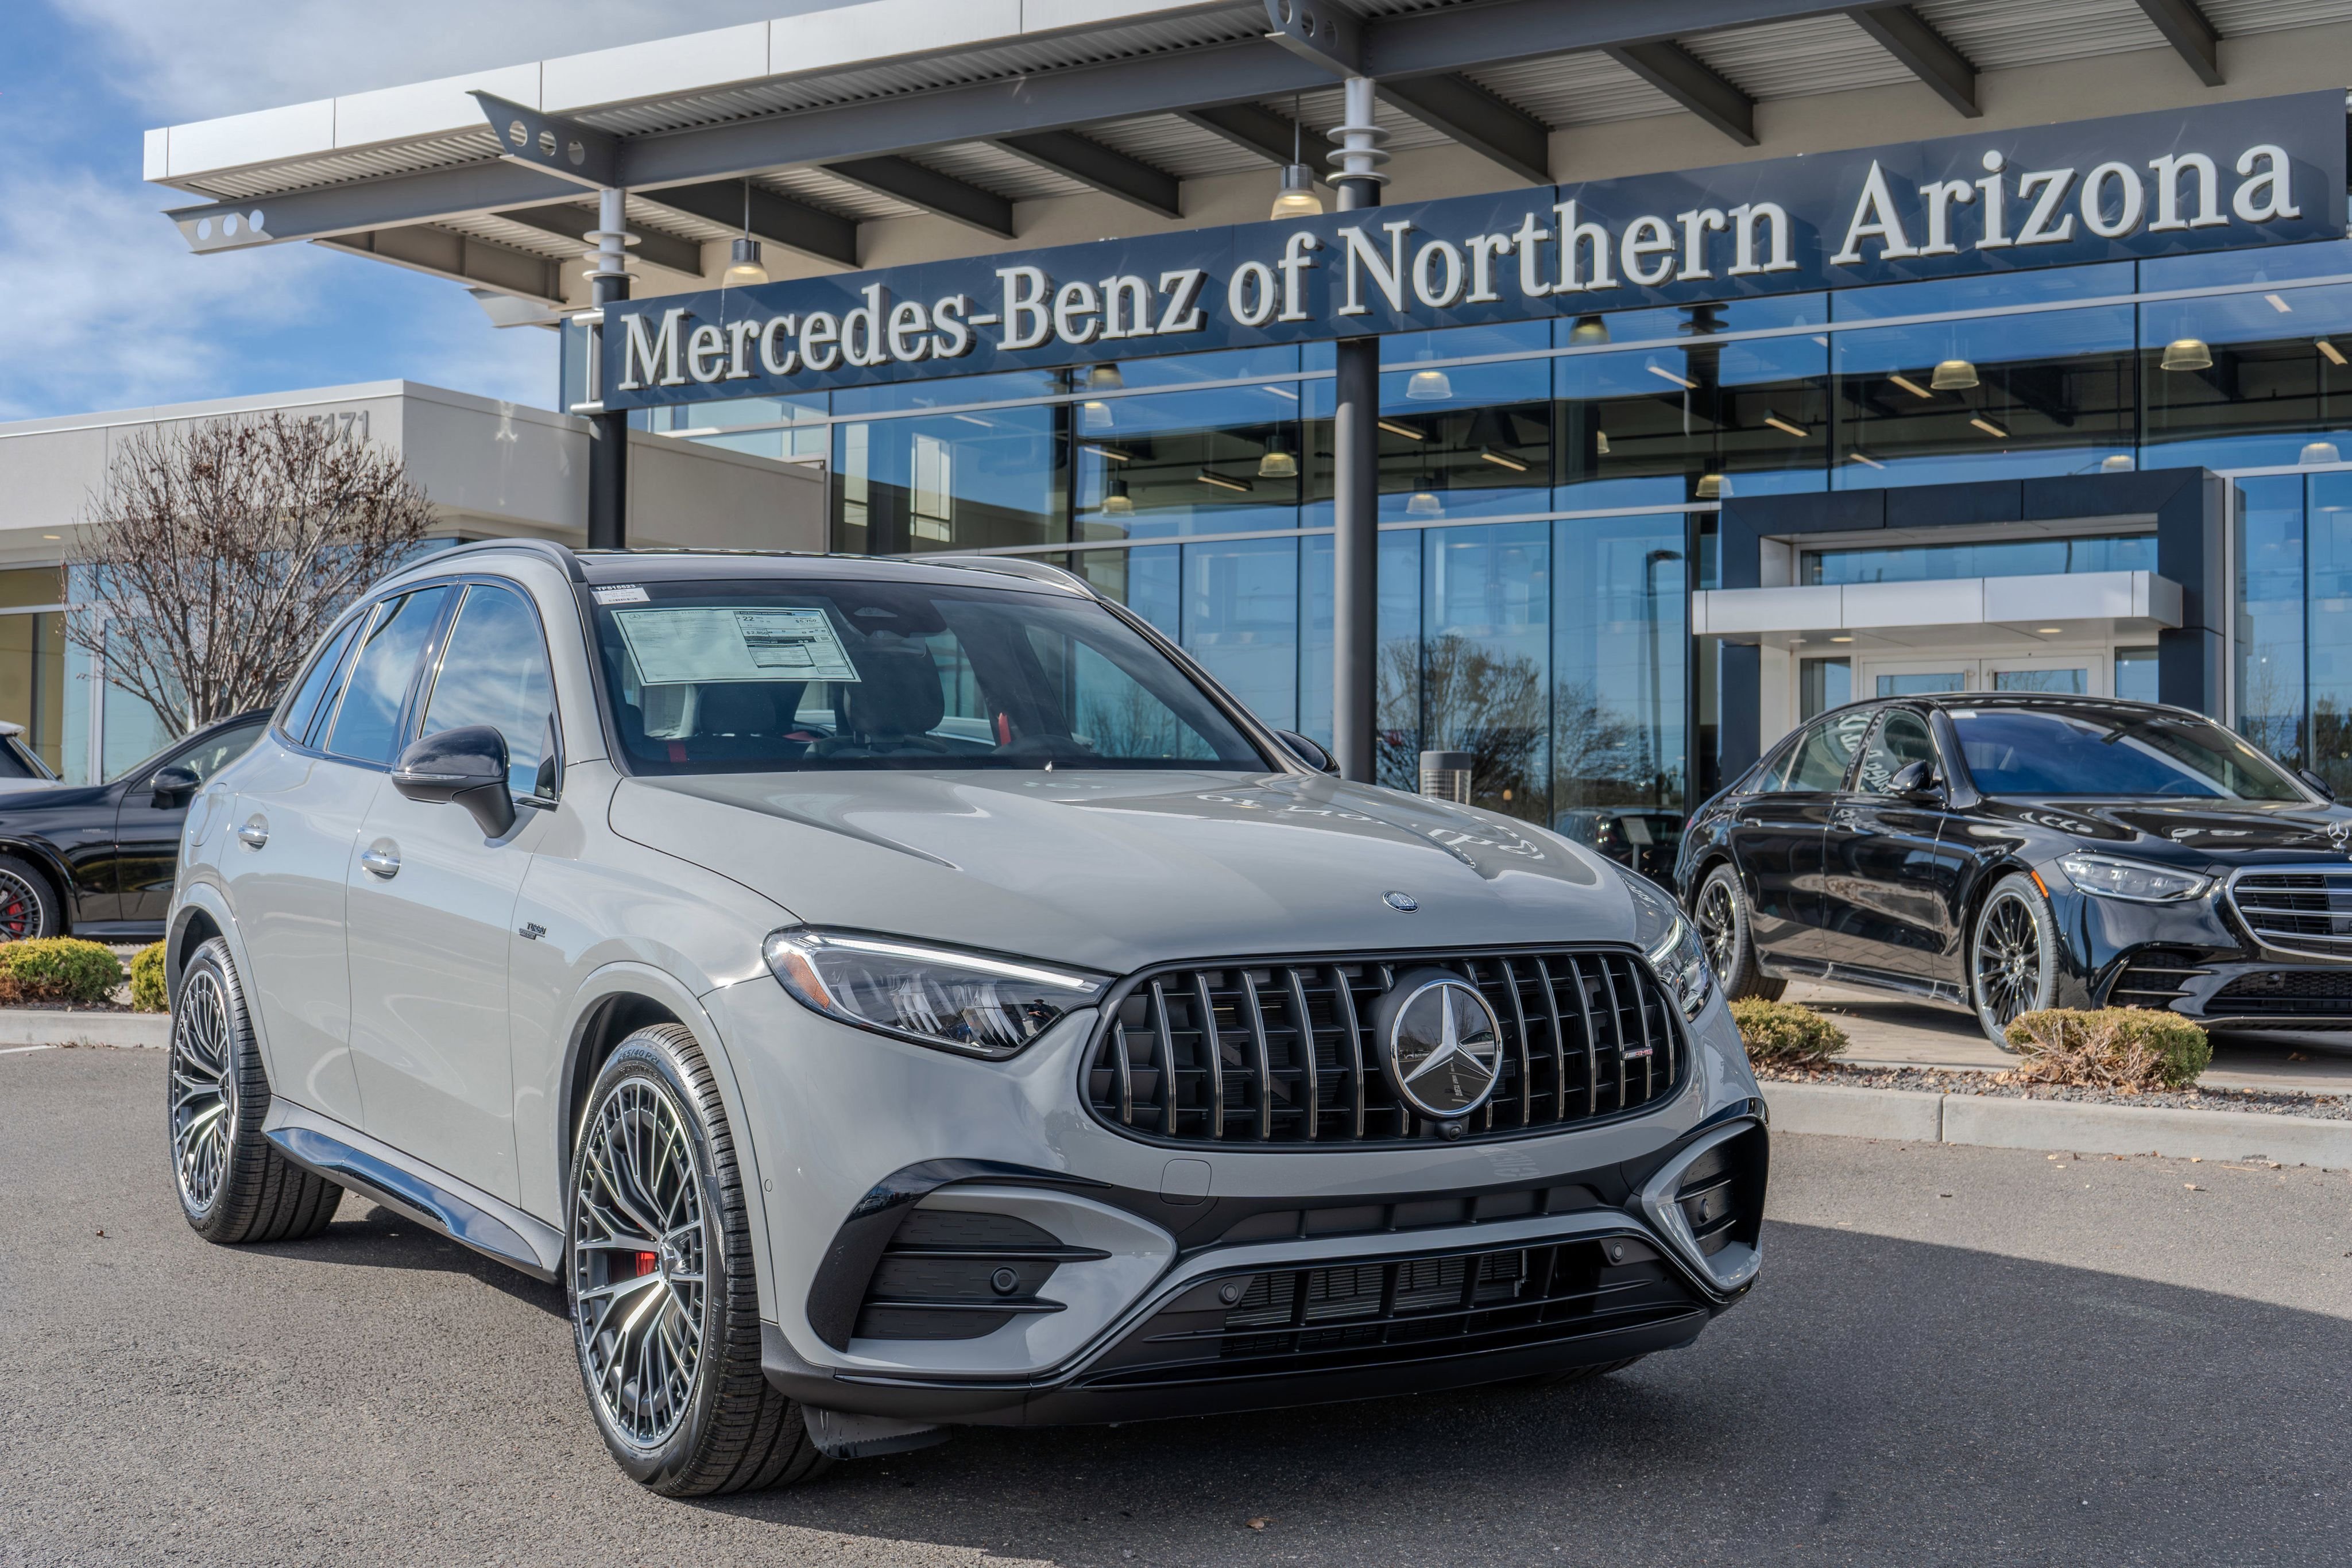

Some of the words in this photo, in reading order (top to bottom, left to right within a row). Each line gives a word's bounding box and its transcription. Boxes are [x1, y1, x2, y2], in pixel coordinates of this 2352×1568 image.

[618, 265, 1205, 392] Mercedes-Benz
[1228, 230, 1322, 328] of
[1337, 198, 1798, 317] Northern
[1829, 144, 2301, 266] Arizona
